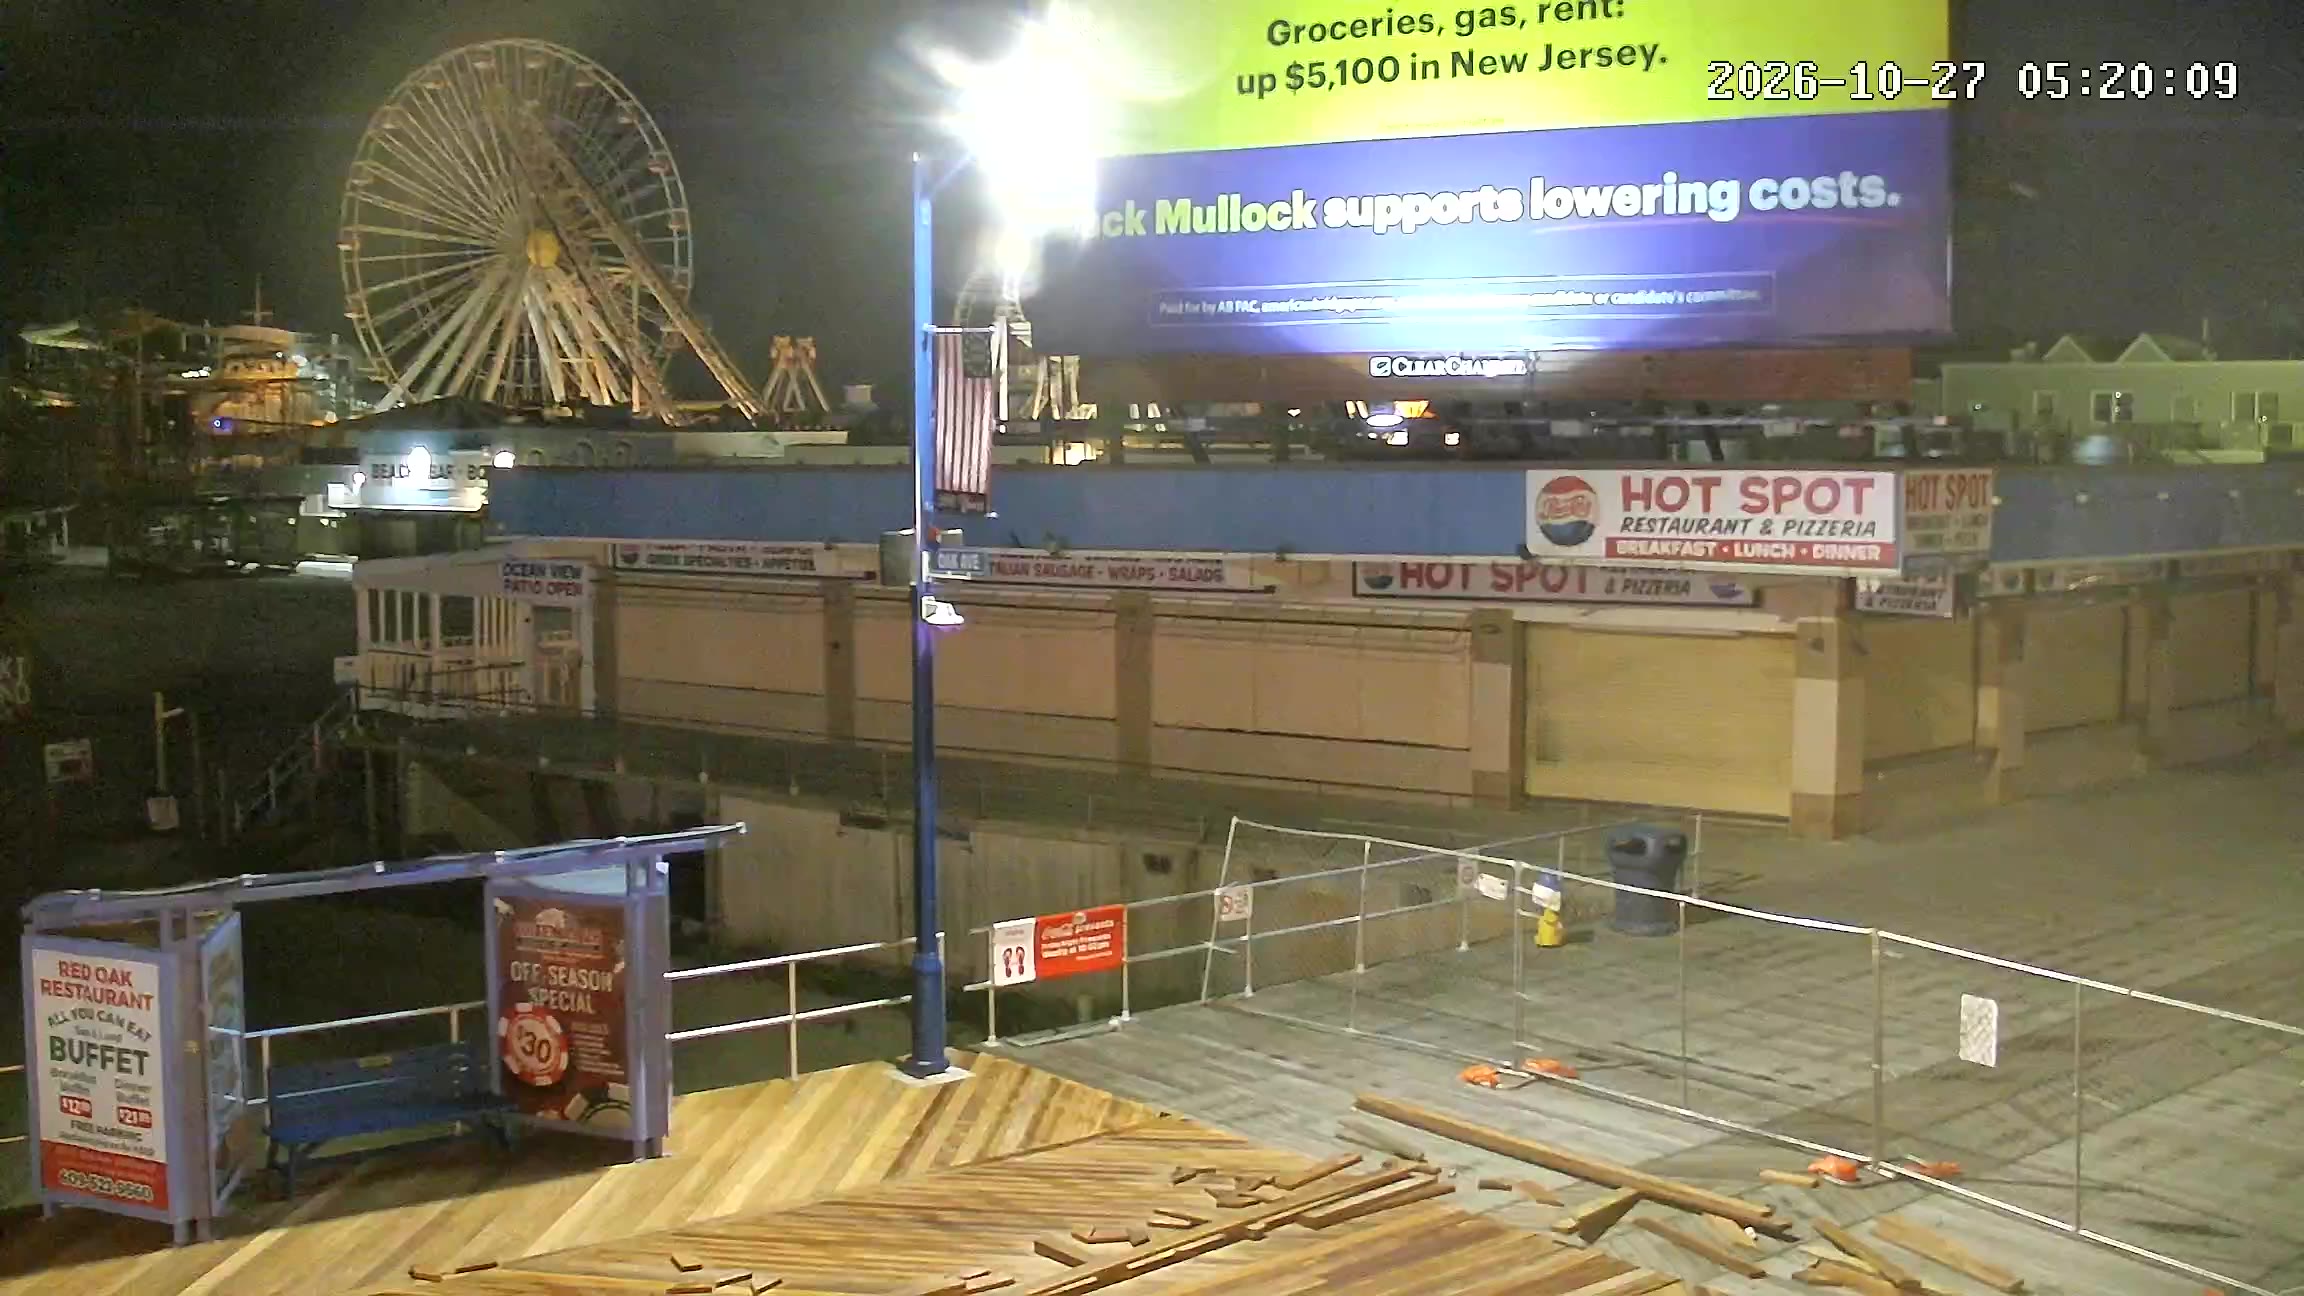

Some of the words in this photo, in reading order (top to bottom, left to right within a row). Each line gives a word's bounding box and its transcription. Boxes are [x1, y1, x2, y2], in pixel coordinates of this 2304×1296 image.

[1267, 8, 1445, 47] Groceries,
[1454, 3, 1526, 37] gas,
[1537, 0, 1624, 25] rent:
[1237, 71, 1277, 100] up
[1285, 55, 1400, 95] $5,100
[1409, 52, 1440, 82] in
[1451, 48, 1528, 79] New
[1538, 42, 1668, 72] Jersey.
[1155, 189, 1318, 235] Mullock
[1322, 184, 1525, 235] supports
[1528, 170, 1741, 223] lowering
[1748, 170, 1900, 211] costs.
[1621, 475, 1722, 513] HOT
[1739, 475, 1875, 516] SPOT
[1904, 474, 1941, 512] HOT
[1945, 473, 1990, 511] SPOT
[1620, 516, 1753, 537] RESTAURANT
[1760, 519, 1772, 536] &
[1782, 518, 1877, 537] PIZZERIA
[1616, 540, 1717, 558] BREAKFAST
[1734, 543, 1796, 559] LUNCH
[1812, 543, 1881, 561] DINNER
[503, 561, 546, 578] OCEAN
[1107, 565, 1156, 581] WRAPS
[1169, 566, 1225, 583] SALADS
[1400, 562, 1475, 591] HOT
[1490, 562, 1589, 593] SPOT
[1621, 577, 1691, 597] PIZZERIA
[58, 960, 91, 981] RED
[95, 966, 133, 988] OAK
[510, 960, 541, 982] OFF
[548, 965, 614, 992] SEASON
[40, 978, 155, 1012] RESTAURANT
[527, 987, 595, 1015] SPECIAL
[47, 1010, 71, 1028] ALL
[70, 1007, 95, 1020] YOU
[96, 1010, 126, 1028] CAN
[126, 1021, 153, 1042] EAT
[49, 1035, 151, 1076] BUFFET
